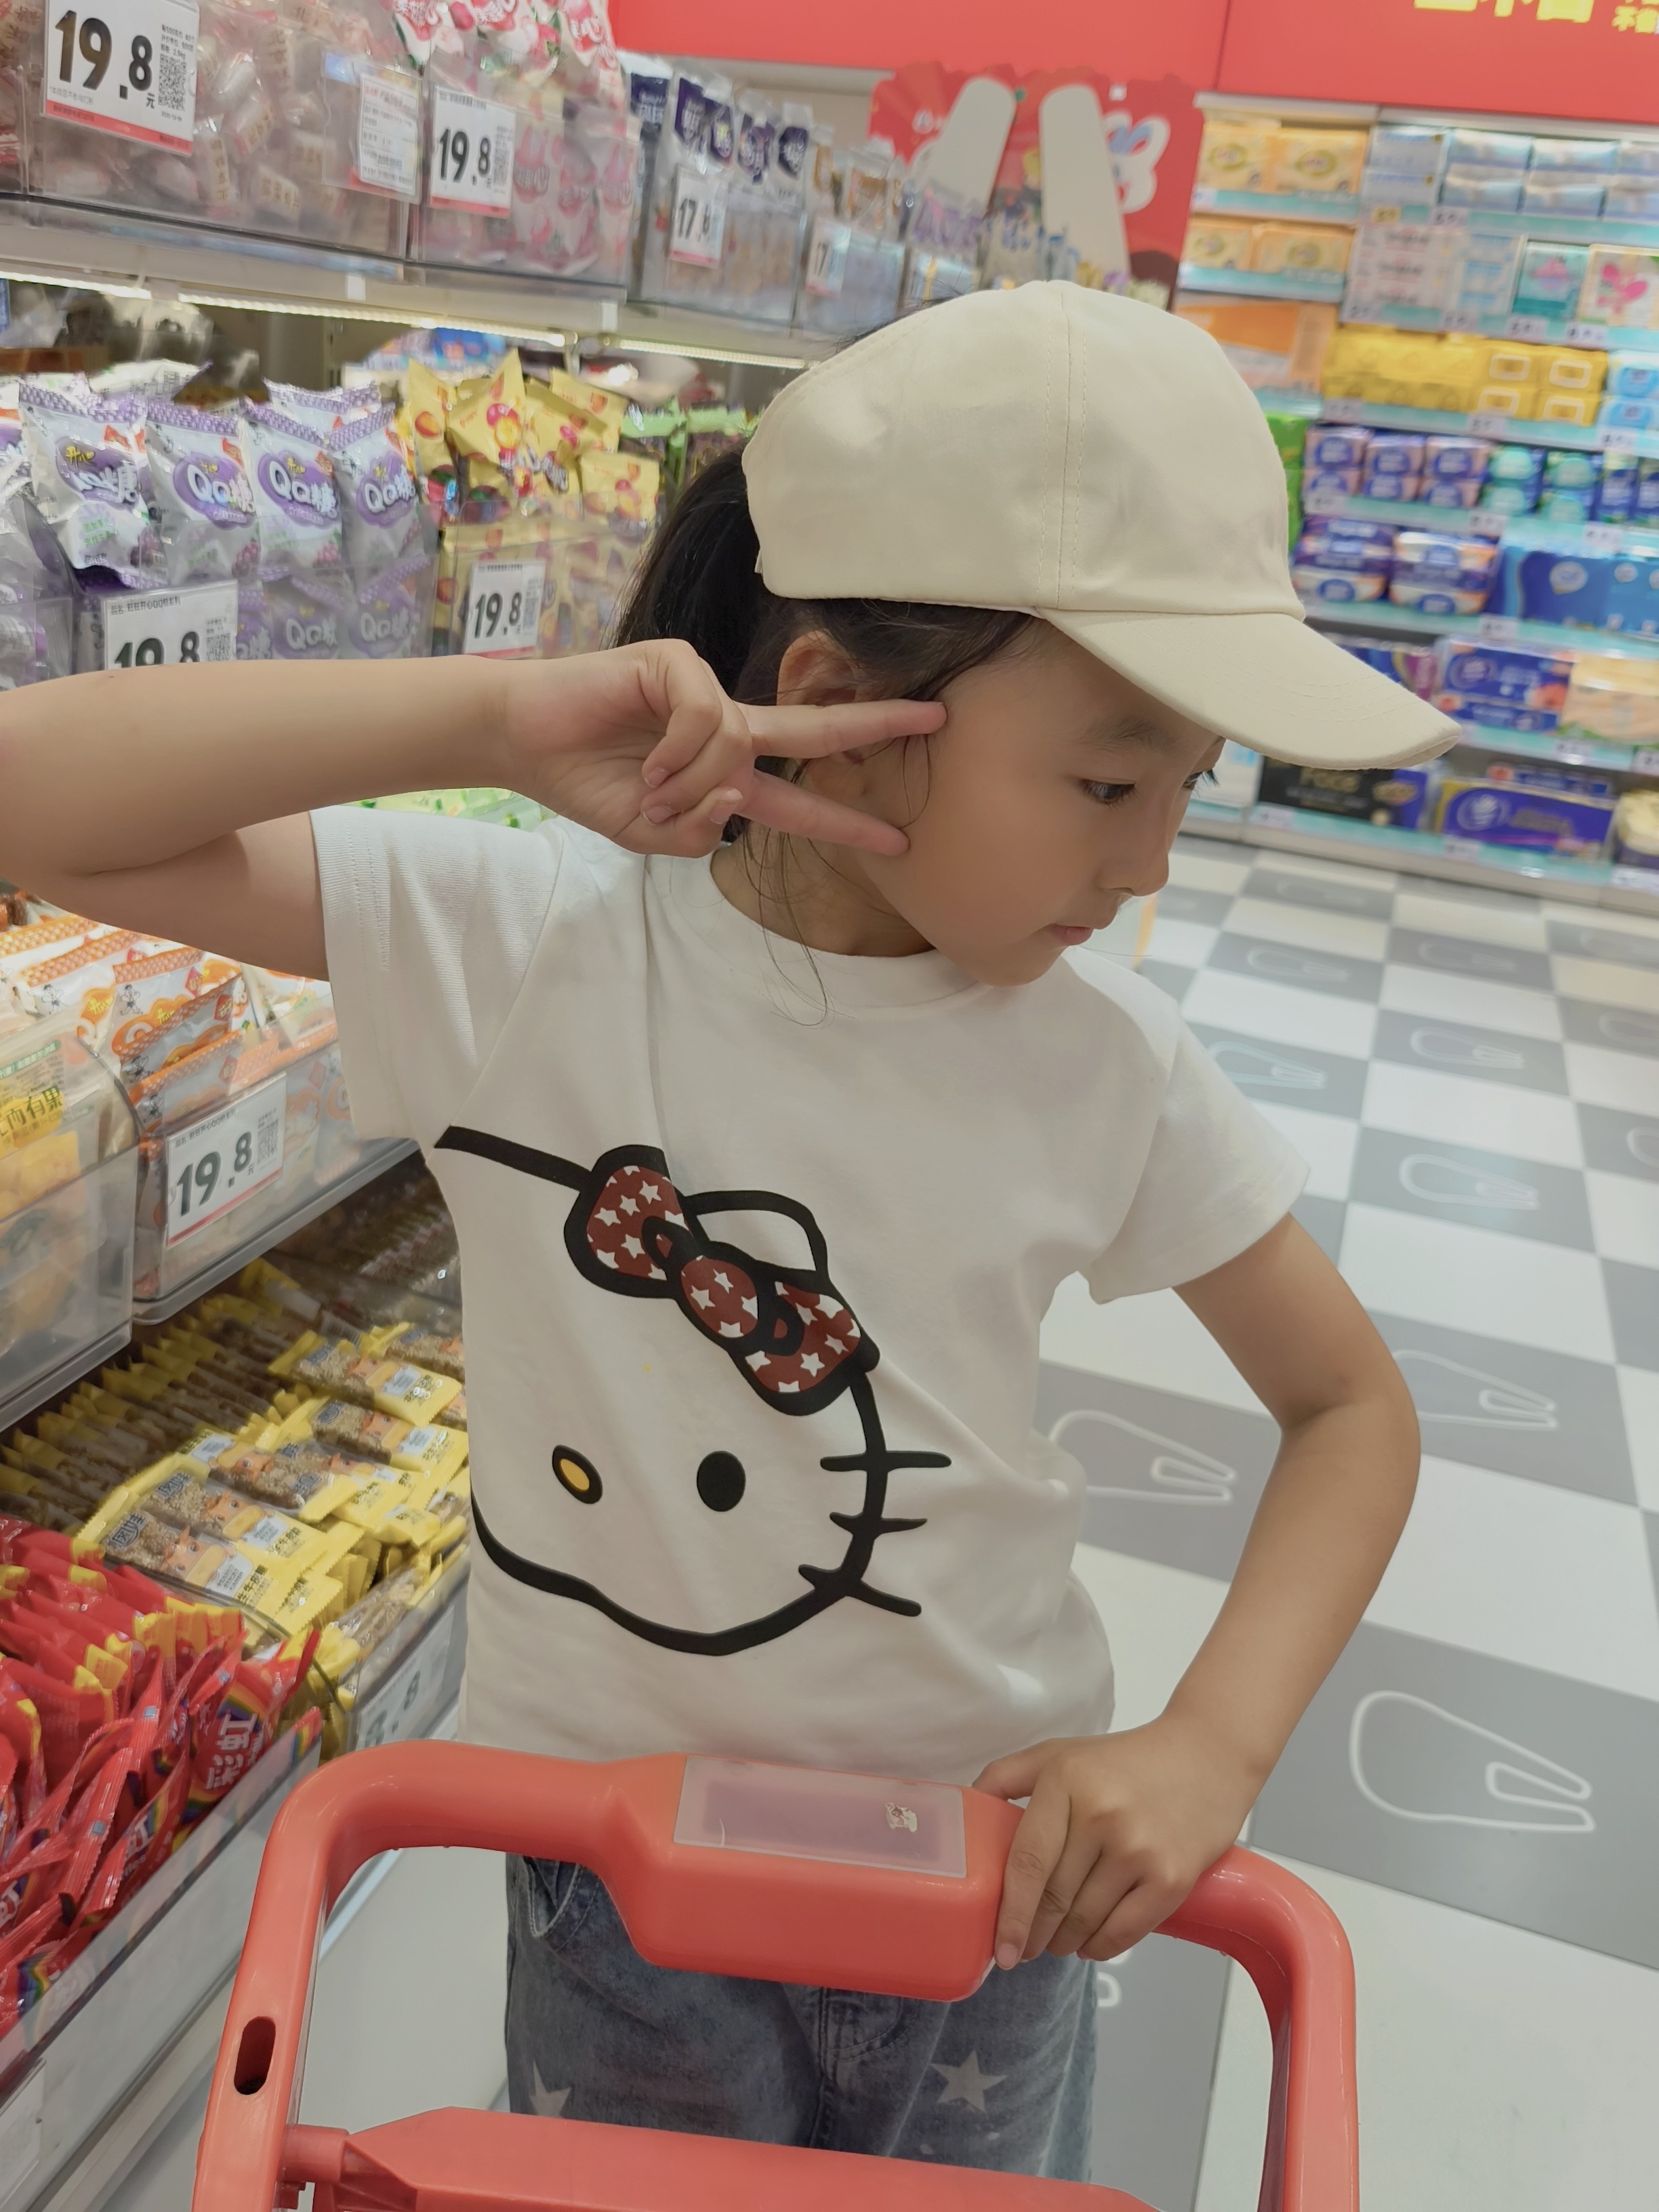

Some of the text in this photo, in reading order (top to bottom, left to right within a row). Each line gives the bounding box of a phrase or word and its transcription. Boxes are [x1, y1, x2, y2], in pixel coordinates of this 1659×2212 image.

[55, 9, 153, 100] 19.8
[146, 92, 156, 109] 元
[439, 128, 492, 186] 19.8
[474, 592, 523, 639] 19.8
[177, 1131, 252, 1217] 19.8
